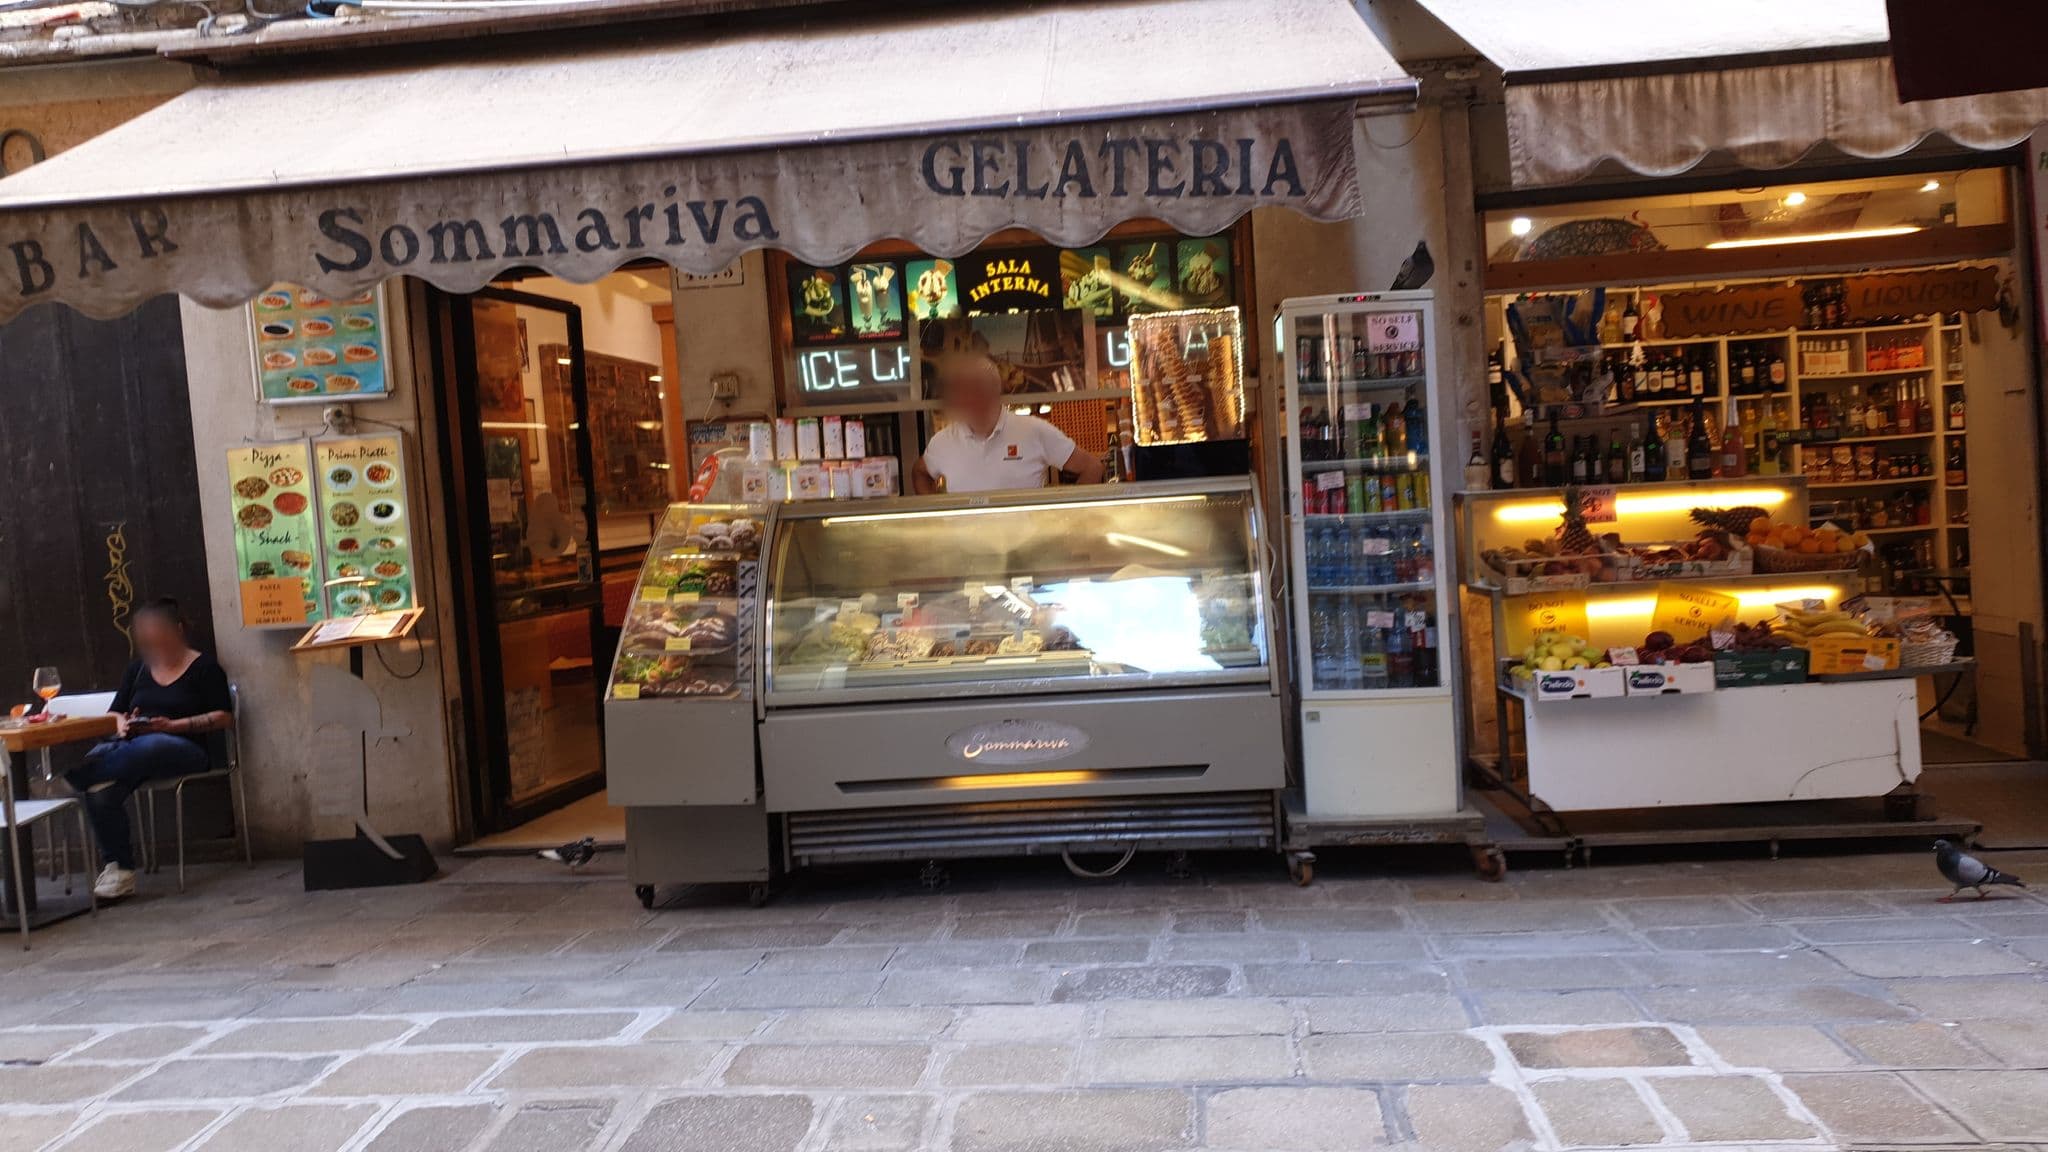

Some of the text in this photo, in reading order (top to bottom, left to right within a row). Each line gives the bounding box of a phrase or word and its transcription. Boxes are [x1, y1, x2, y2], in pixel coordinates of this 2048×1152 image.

[921, 137, 1307, 200] GELATERIA
[315, 186, 780, 274] Sommariva
[8, 204, 178, 297] BAR
[985, 259, 1032, 277] SALA
[969, 276, 1049, 303] INTERNA
[1681, 297, 1785, 325] WINE
[800, 349, 860, 393] ICE
[251, 448, 283, 468] Pizza
[328, 445, 388, 461] Primi Piatti
[258, 531, 293, 546] Snack
[963, 731, 1070, 758] Sommariva
